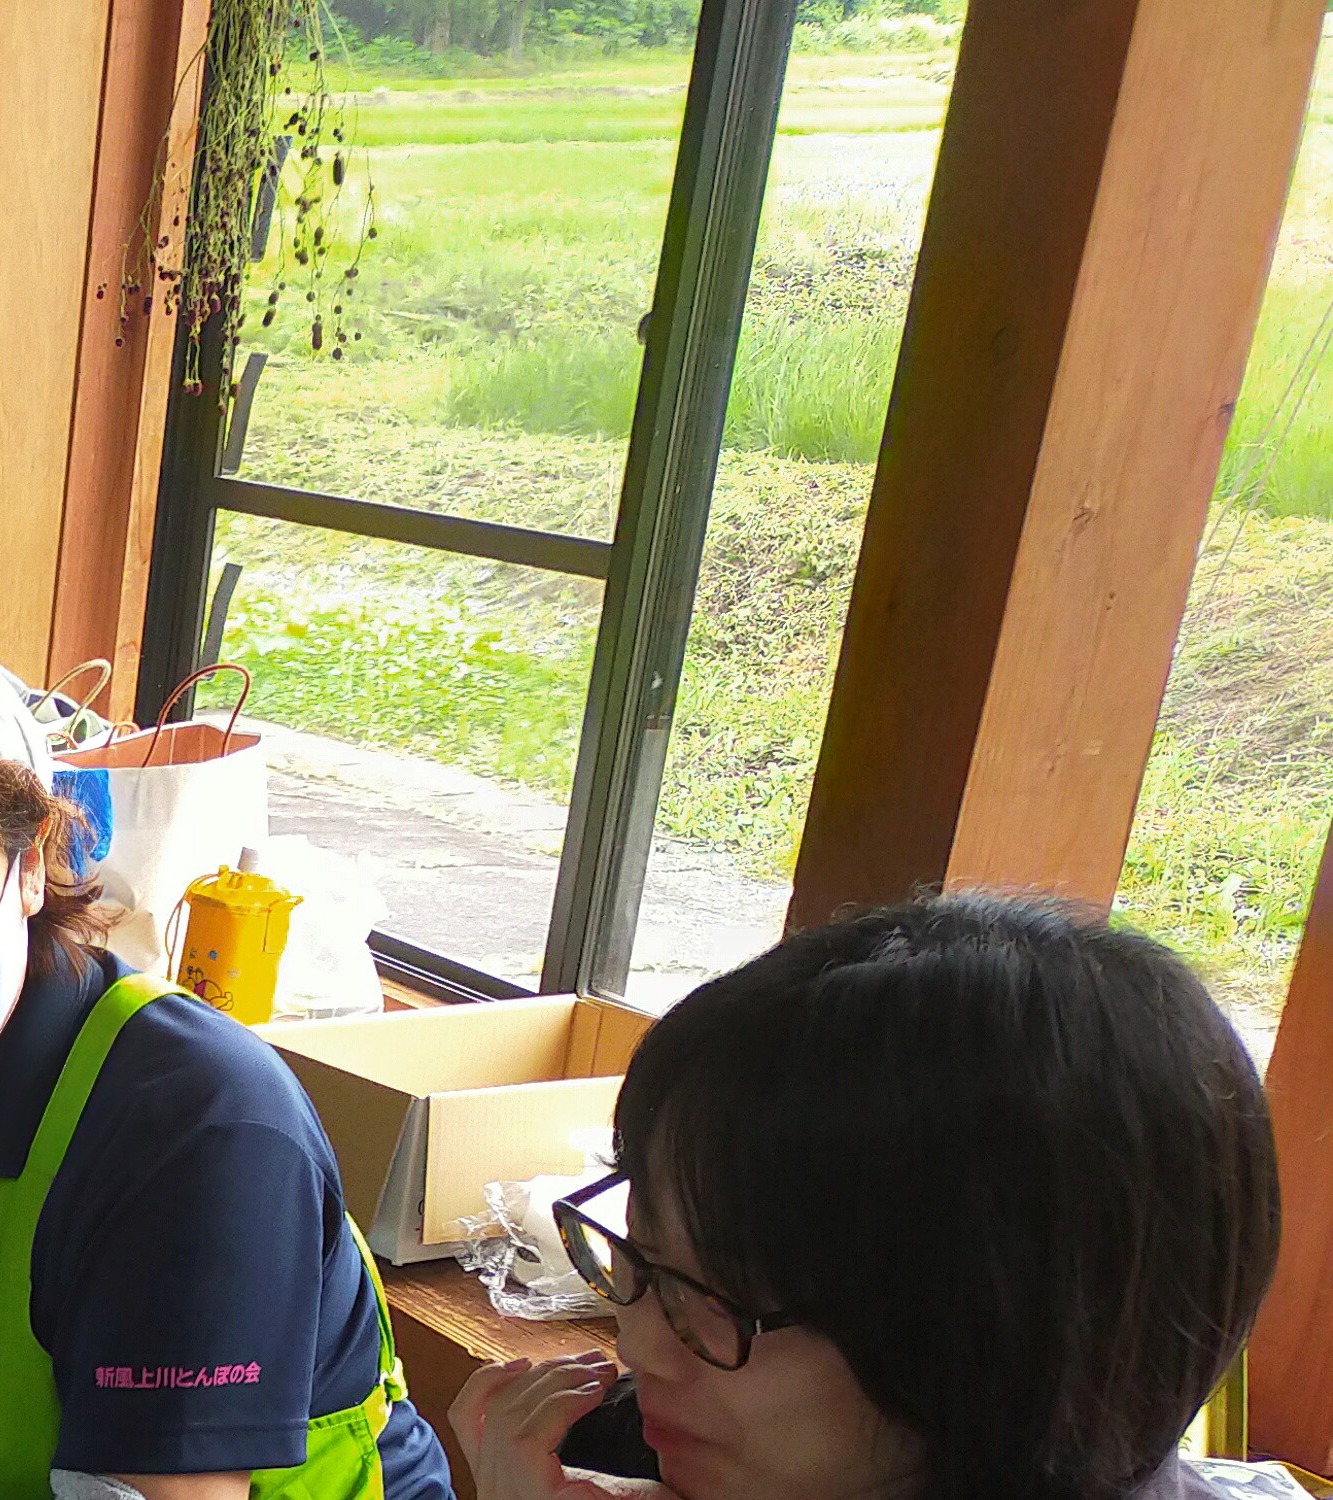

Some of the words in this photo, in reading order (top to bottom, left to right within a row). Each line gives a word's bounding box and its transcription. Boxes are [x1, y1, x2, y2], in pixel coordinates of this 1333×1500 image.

[95, 1360, 262, 1389] 新風上川とんぼの会
